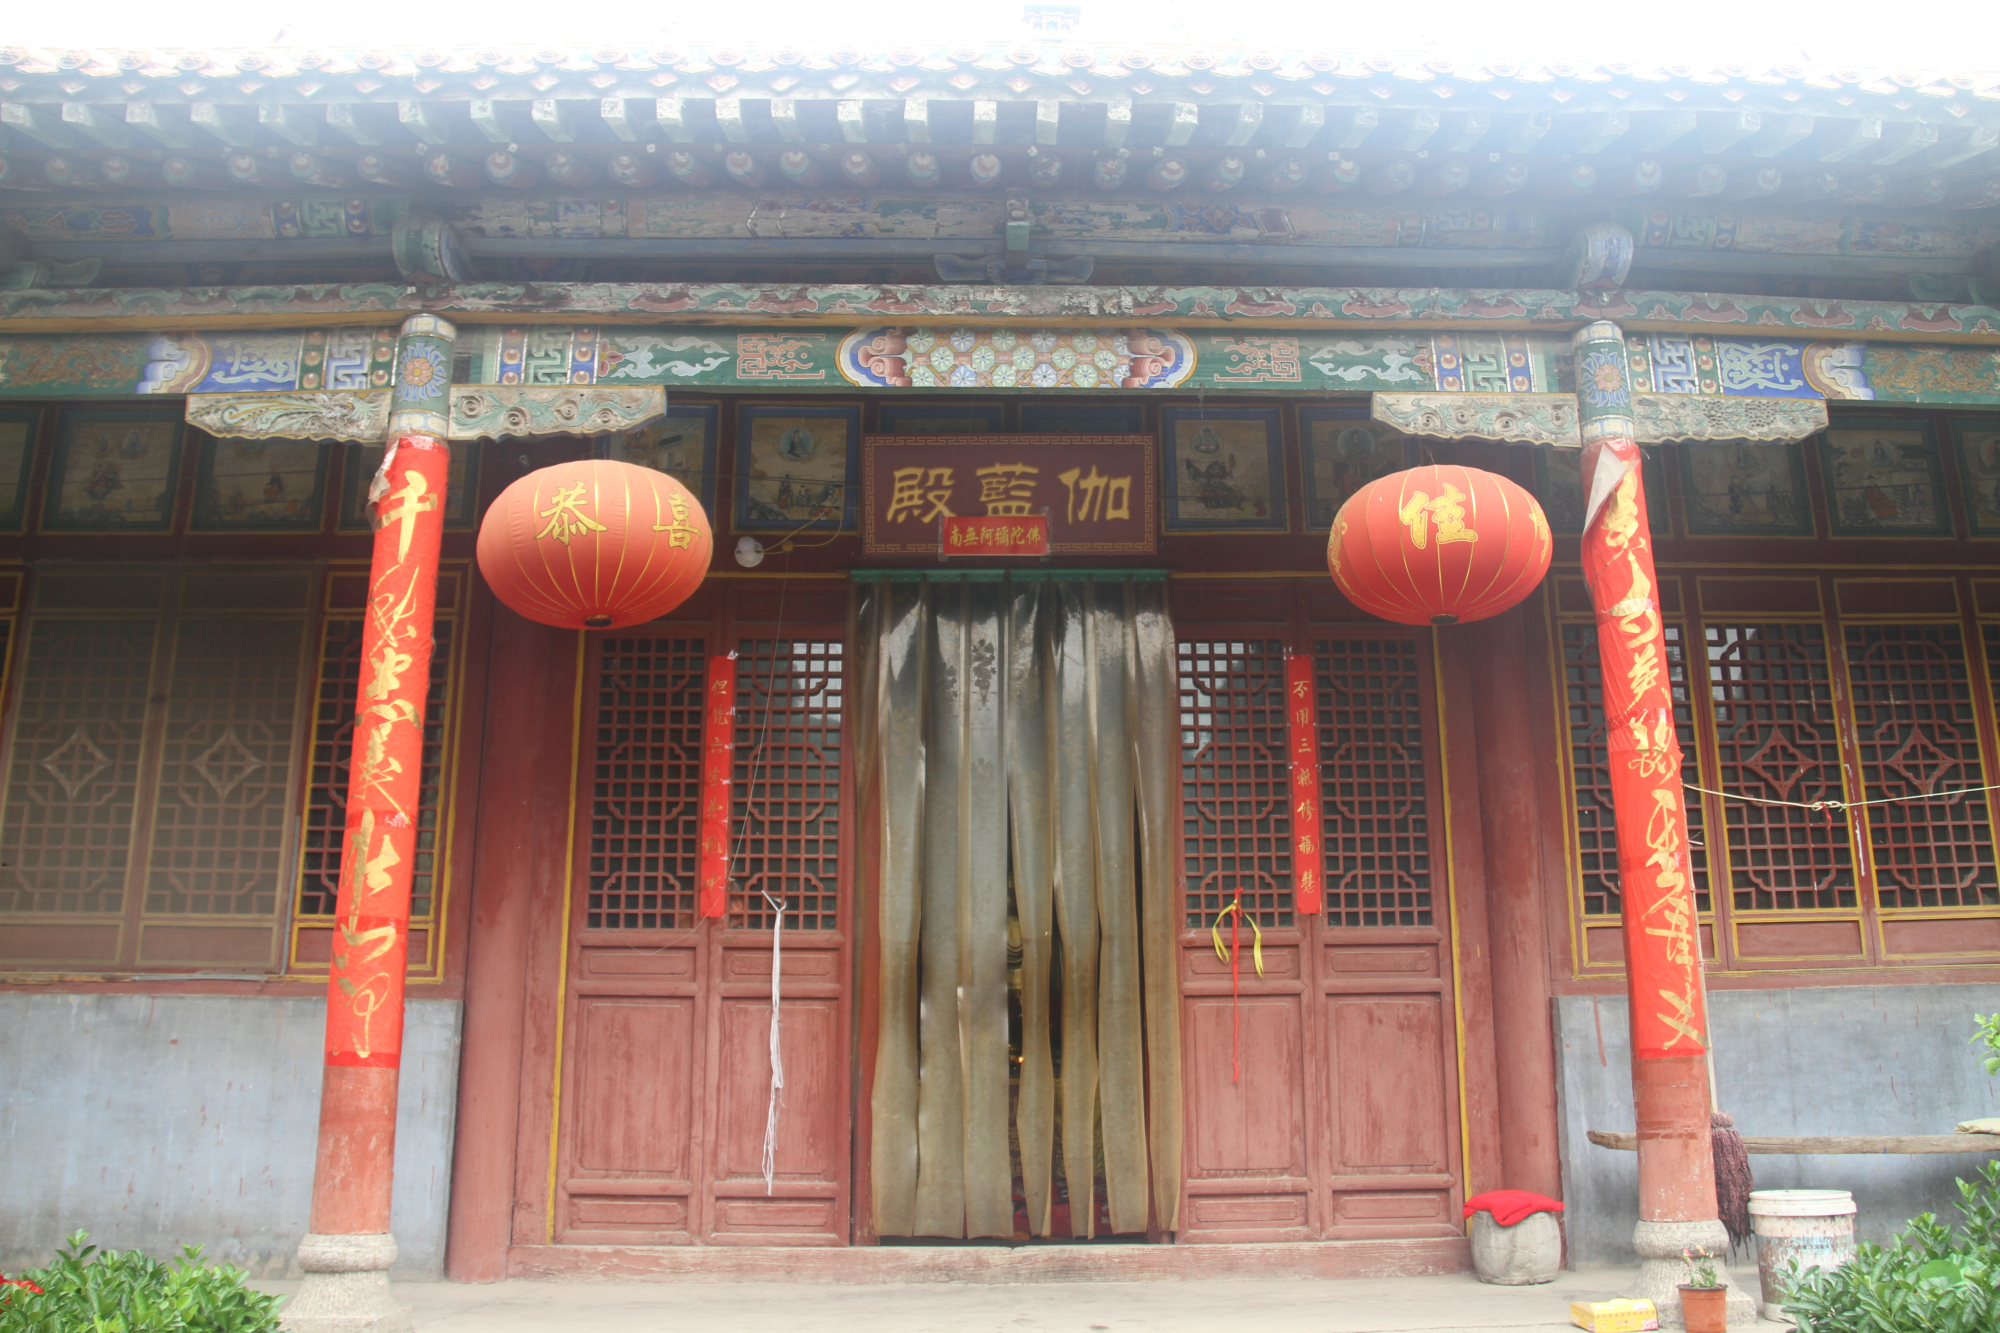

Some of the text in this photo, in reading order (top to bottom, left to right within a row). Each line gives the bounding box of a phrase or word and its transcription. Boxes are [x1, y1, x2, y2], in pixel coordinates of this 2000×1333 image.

[534, 481, 702, 551] 恭喜
[949, 524, 1041, 548] 南無阿彌陀佛
[1400, 482, 1478, 549] 佳
